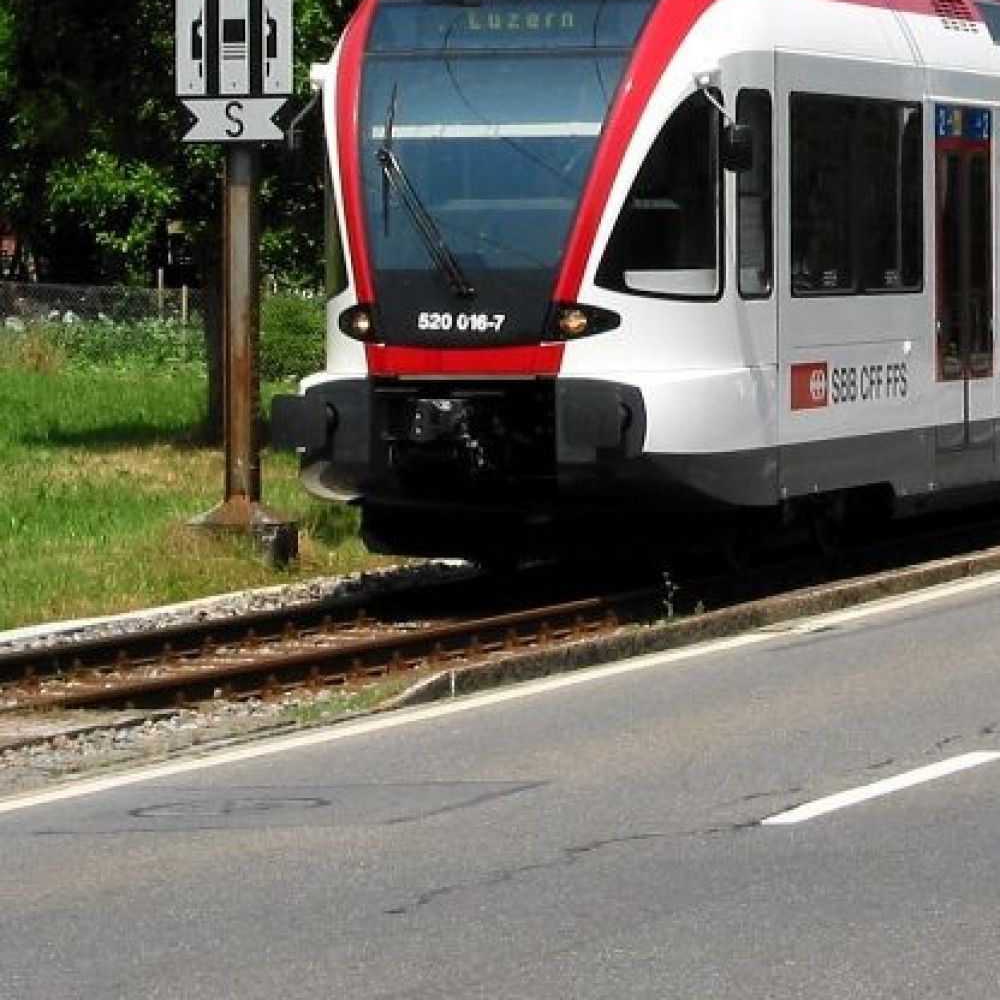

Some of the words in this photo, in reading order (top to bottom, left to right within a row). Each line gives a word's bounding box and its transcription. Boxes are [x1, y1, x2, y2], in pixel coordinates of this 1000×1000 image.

[468, 9, 574, 30] Luzern
[225, 101, 244, 138] S
[418, 311, 453, 331] 520
[456, 312, 506, 333] 016-7
[832, 367, 857, 405] SBB
[860, 364, 883, 401] CFF
[886, 362, 907, 399] FFS
